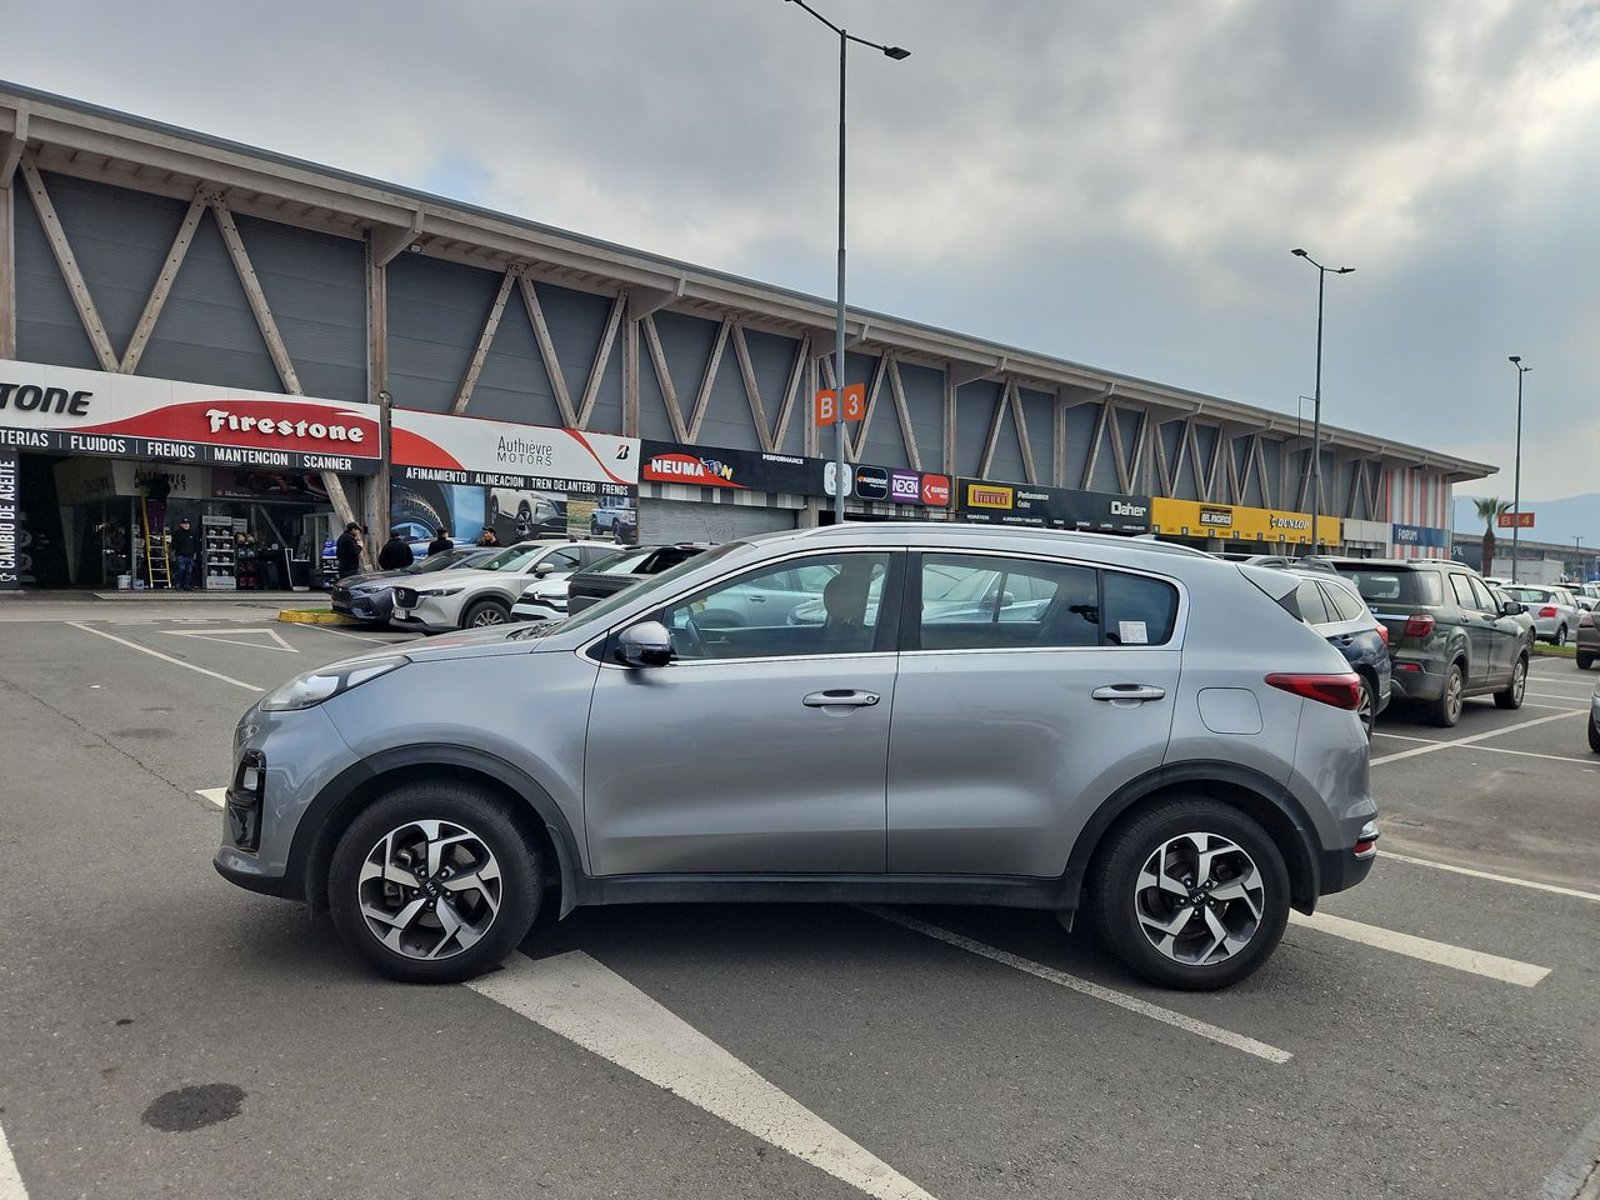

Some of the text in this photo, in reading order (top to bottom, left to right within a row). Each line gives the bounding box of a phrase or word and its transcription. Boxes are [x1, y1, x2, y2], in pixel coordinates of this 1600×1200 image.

[820, 394, 859, 419] B 3
[205, 408, 365, 443] Firestone
[71, 435, 126, 453] FLUIDOS
[147, 442, 196, 459] FRENOS
[214, 447, 288, 466] MANTENCION
[303, 455, 352, 471] SCANNER
[497, 452, 552, 467] MOTORS
[762, 454, 804, 464] PERFORMANCE
[406, 467, 628, 496] AFINAMIENTO ALINEACION TREN DELANTERO FRENOS
[974, 489, 1009, 505] PIRELLI
[0, 461, 15, 569] CAMBIO DE ACEITE
[1110, 501, 1147, 517] Daher
[1278, 518, 1310, 530] DUNLOP
[1522, 516, 1530, 525] 4
